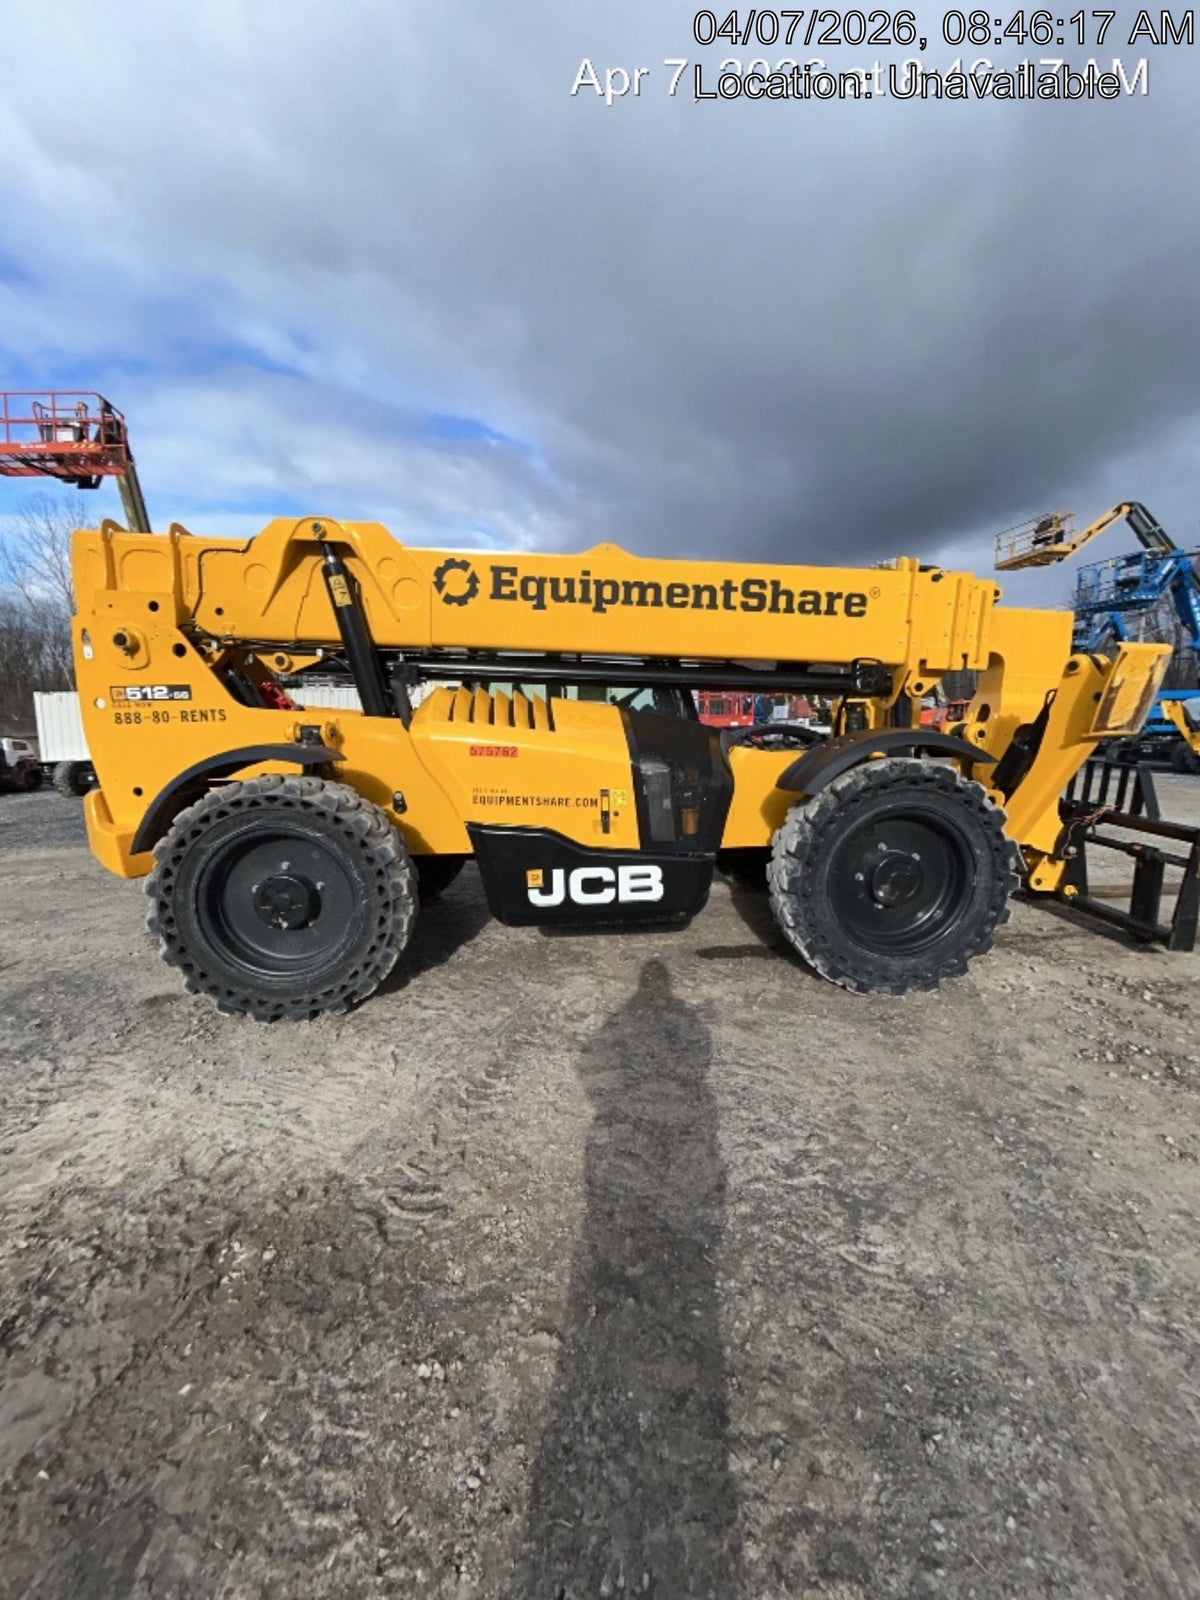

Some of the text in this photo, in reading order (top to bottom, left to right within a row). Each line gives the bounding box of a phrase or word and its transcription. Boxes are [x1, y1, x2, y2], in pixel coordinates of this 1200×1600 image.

[490, 565, 870, 618] EquipmentShare
[114, 709, 227, 725] 888-80-RENTS
[472, 795, 599, 808] EQUIPMENTSHARE.COM
[527, 865, 664, 907] JCB
